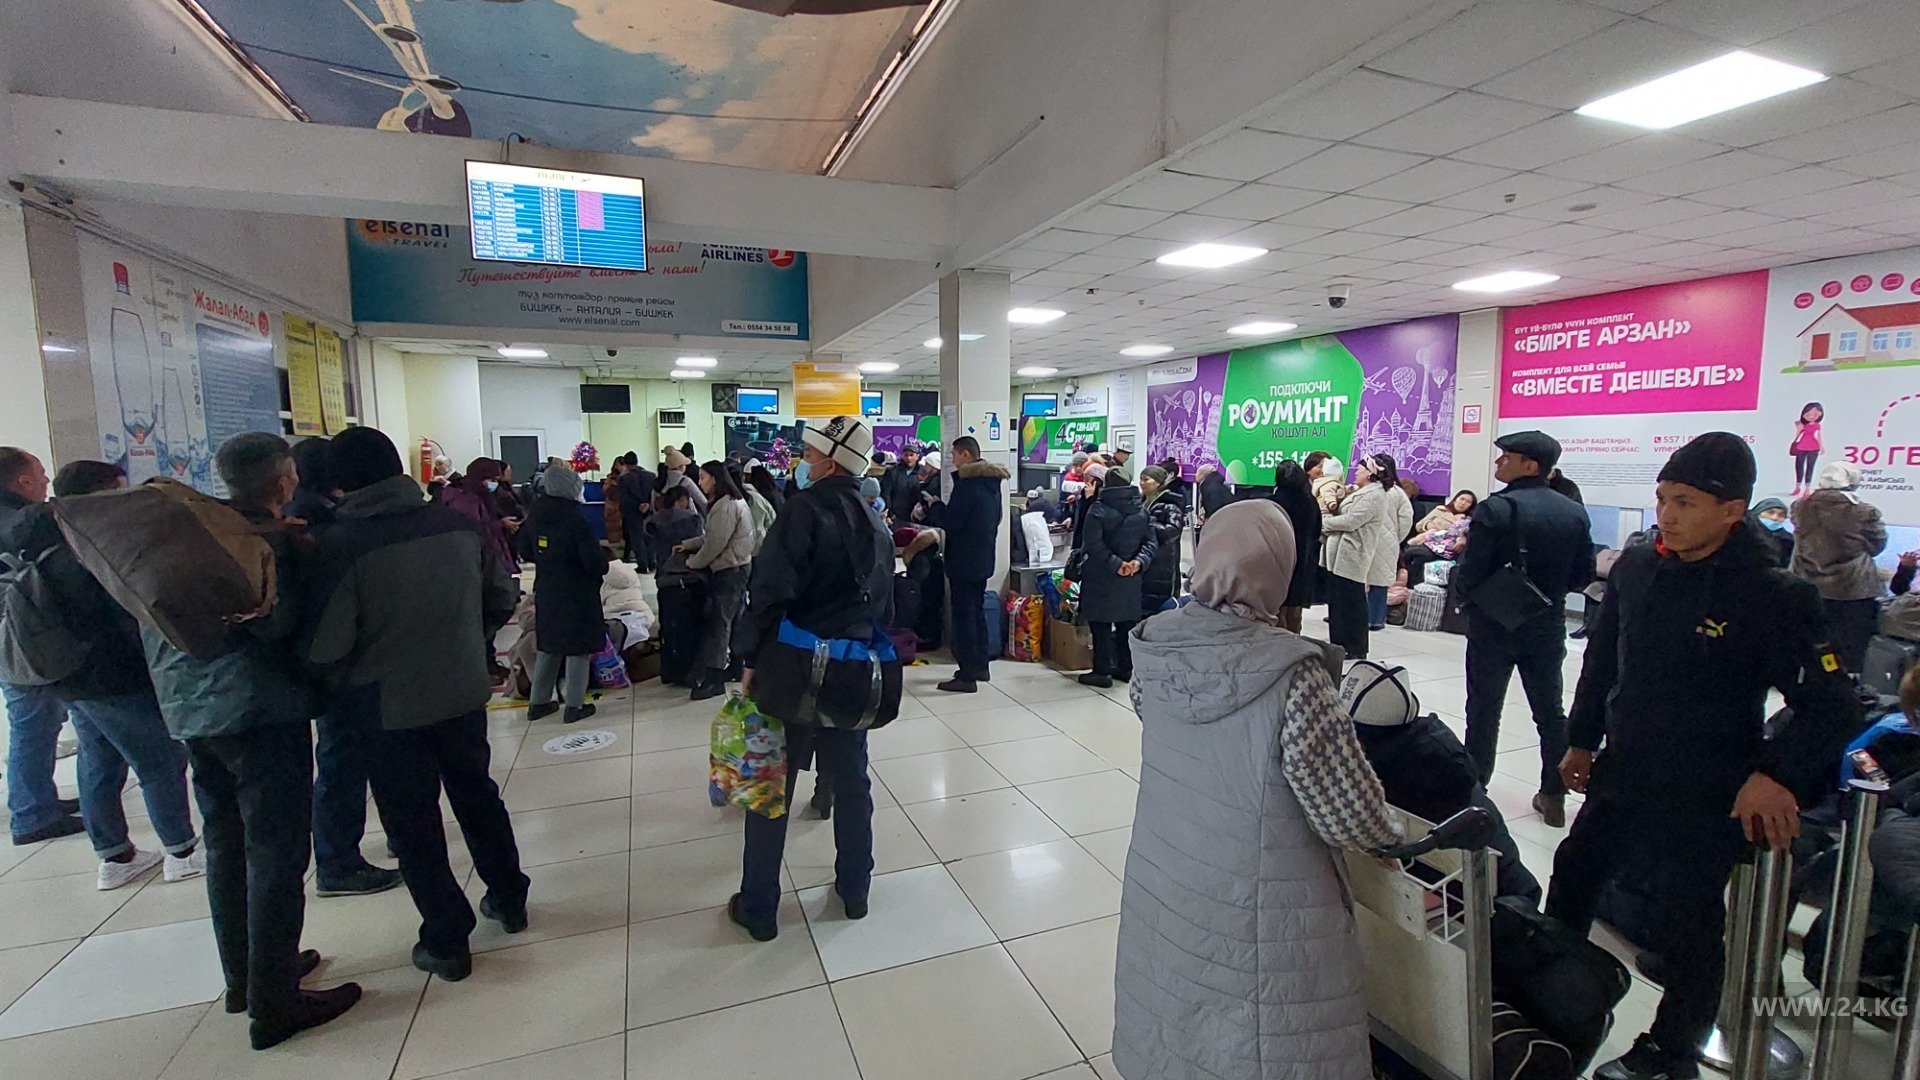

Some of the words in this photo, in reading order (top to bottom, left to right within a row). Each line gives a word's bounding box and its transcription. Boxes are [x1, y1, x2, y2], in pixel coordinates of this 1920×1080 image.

[393, 239, 448, 249] TRAVEL
[701, 248, 764, 263] AIRLINES
[193, 288, 256, 328] Жалал-Абад
[521, 303, 562, 313] БИШКЕК
[576, 305, 621, 315] АНТАЛИЯ
[635, 309, 674, 319] БИШКЕК
[1587, 313, 1635, 326] КОМПЛЕКТ
[1514, 329, 1591, 353] «БИРГЕ
[1596, 319, 1691, 346] АРЗАН»
[1512, 366, 1553, 377] КОМПЛЕКТ
[1554, 365, 1571, 374] ДЛЯ
[1573, 363, 1594, 373] ВСЕЙ
[1511, 374, 1602, 396] «ВМЕСТЕ
[1608, 364, 1745, 394] ДЕШЕВЛЕ»
[1270, 380, 1332, 397] ПОДКЛЮЧИ
[1228, 395, 1348, 429] РОУМИНГ
[1271, 427, 1308, 438] КОШУП
[1311, 426, 1326, 437] АЛ
[1844, 446, 1880, 466] 30
